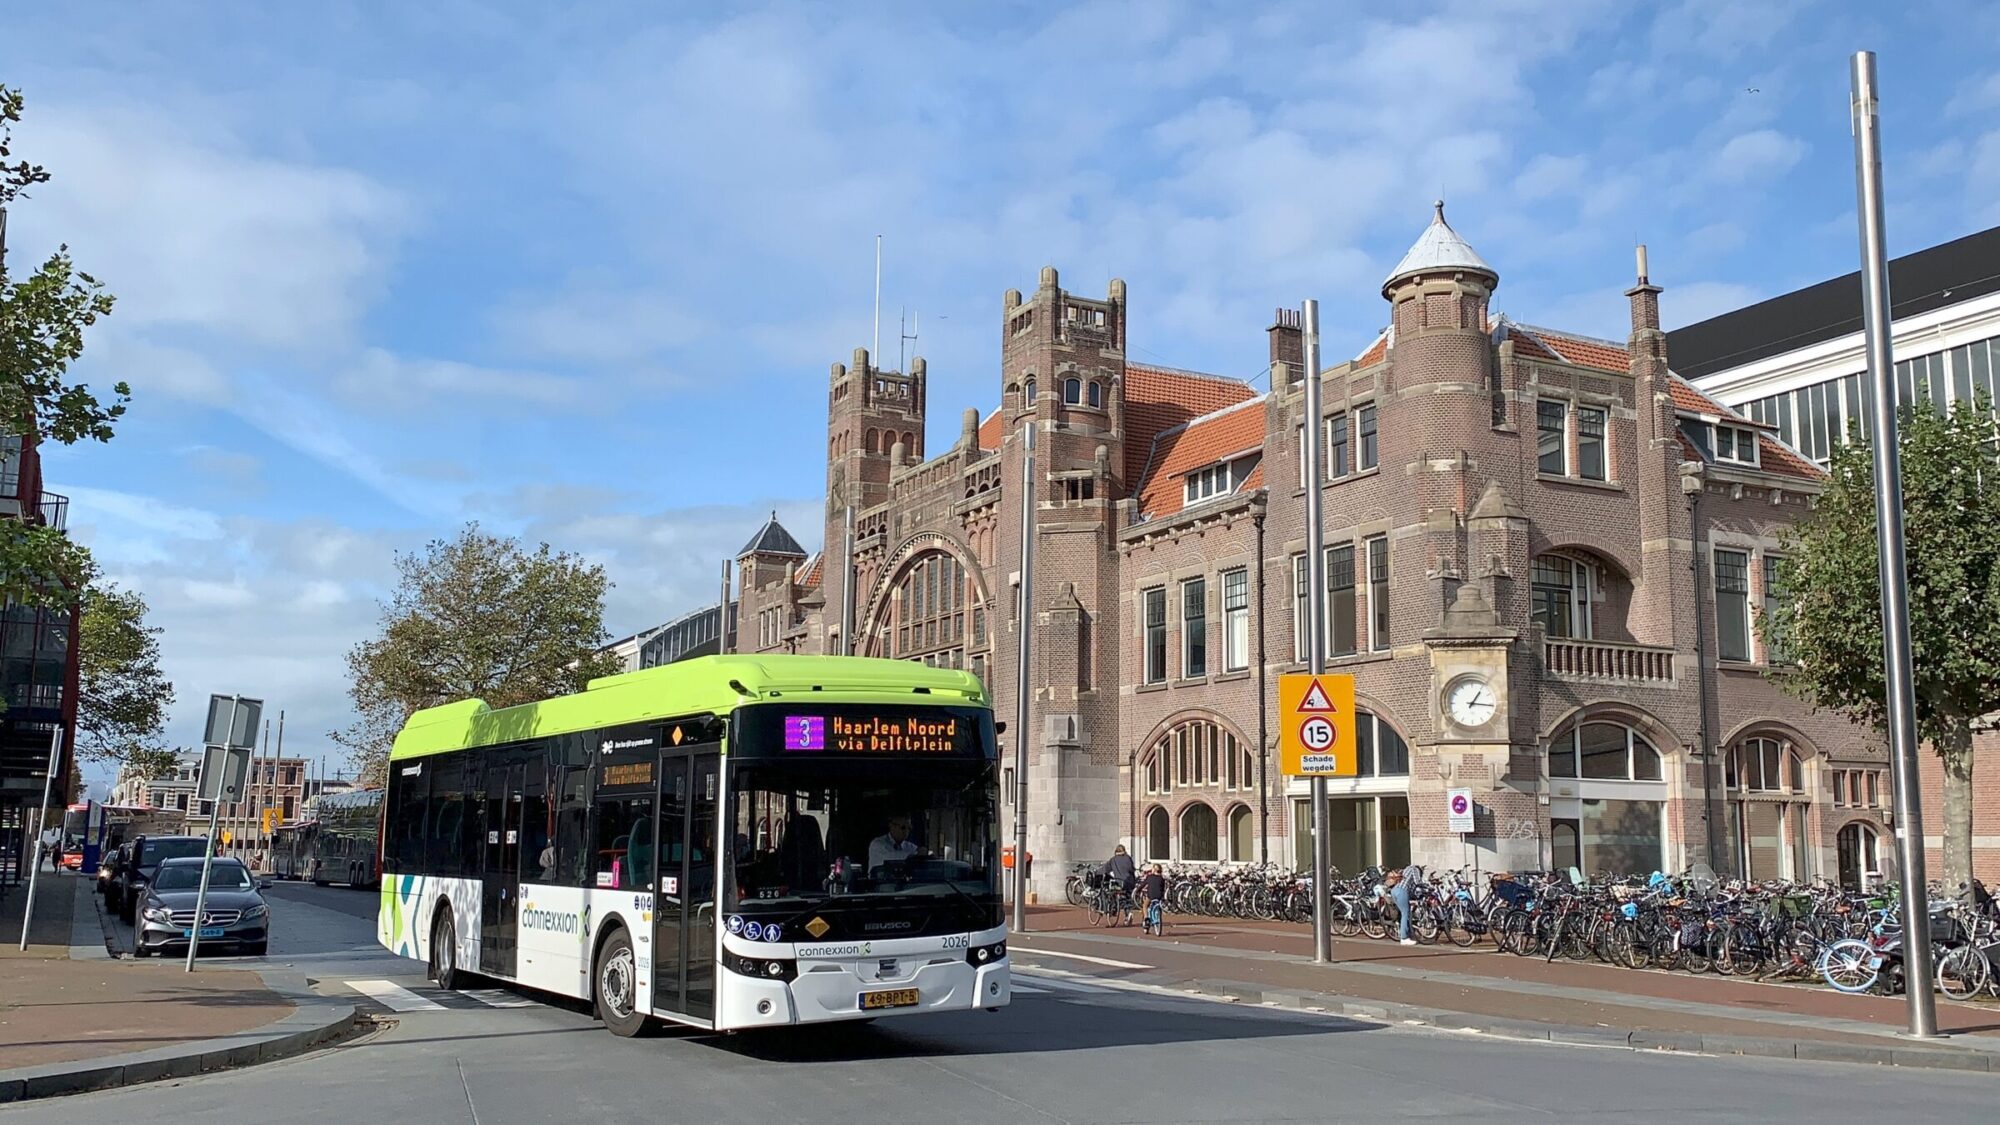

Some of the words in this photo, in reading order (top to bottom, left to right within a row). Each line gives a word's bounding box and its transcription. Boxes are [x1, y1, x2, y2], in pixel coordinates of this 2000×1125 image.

[799, 719, 810, 747] 3
[833, 717, 900, 735] Haarlem
[908, 718, 955, 736] Noord
[838, 737, 863, 750] via
[870, 735, 952, 751] Delftplein
[1308, 726, 1329, 744] 15
[1303, 755, 1333, 763] Schade
[1303, 764, 1335, 773] wegdek
[522, 908, 578, 935] connexxion
[798, 944, 860, 957] connexxion
[942, 936, 968, 949] 2026
